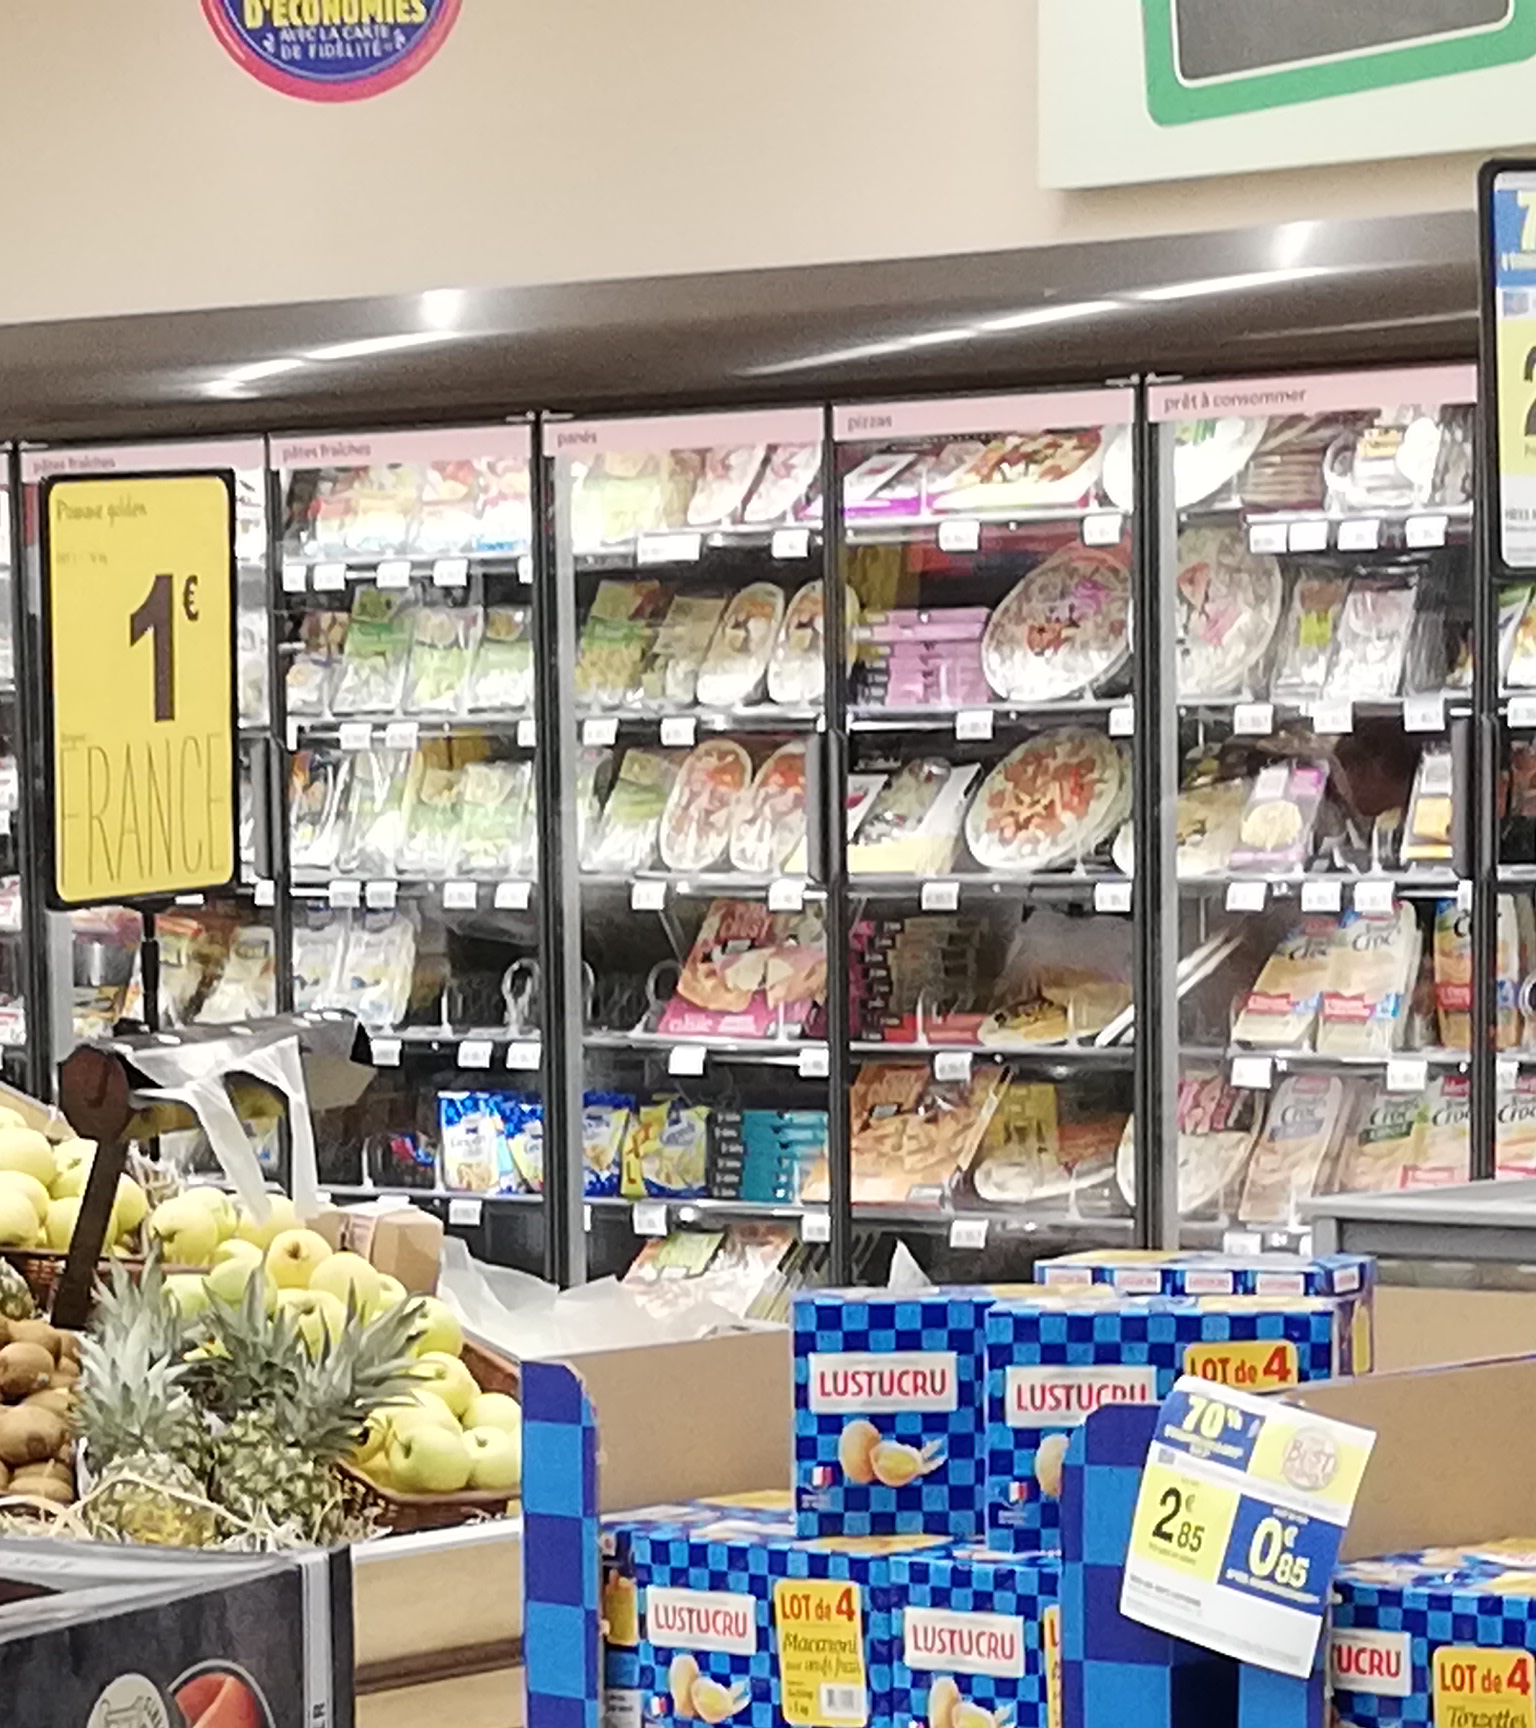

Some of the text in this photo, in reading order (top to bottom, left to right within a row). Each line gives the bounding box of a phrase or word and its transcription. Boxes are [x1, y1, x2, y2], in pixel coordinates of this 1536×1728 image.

[1164, 392, 1198, 413] prêt
[1212, 388, 1307, 409] consommer
[60, 731, 225, 887] FRANCE
[1234, 1357, 1259, 1383] de
[1262, 1345, 1292, 1383] 4
[818, 1368, 947, 1398] LUSTUCRU
[654, 1602, 748, 1639] LUSTUCRU
[781, 1587, 856, 1621] LOT de 4
[782, 1632, 859, 1657] Macaroni
[911, 1623, 1016, 1660] LUSTUCRU
[1440, 1657, 1531, 1697] LOT de 4
